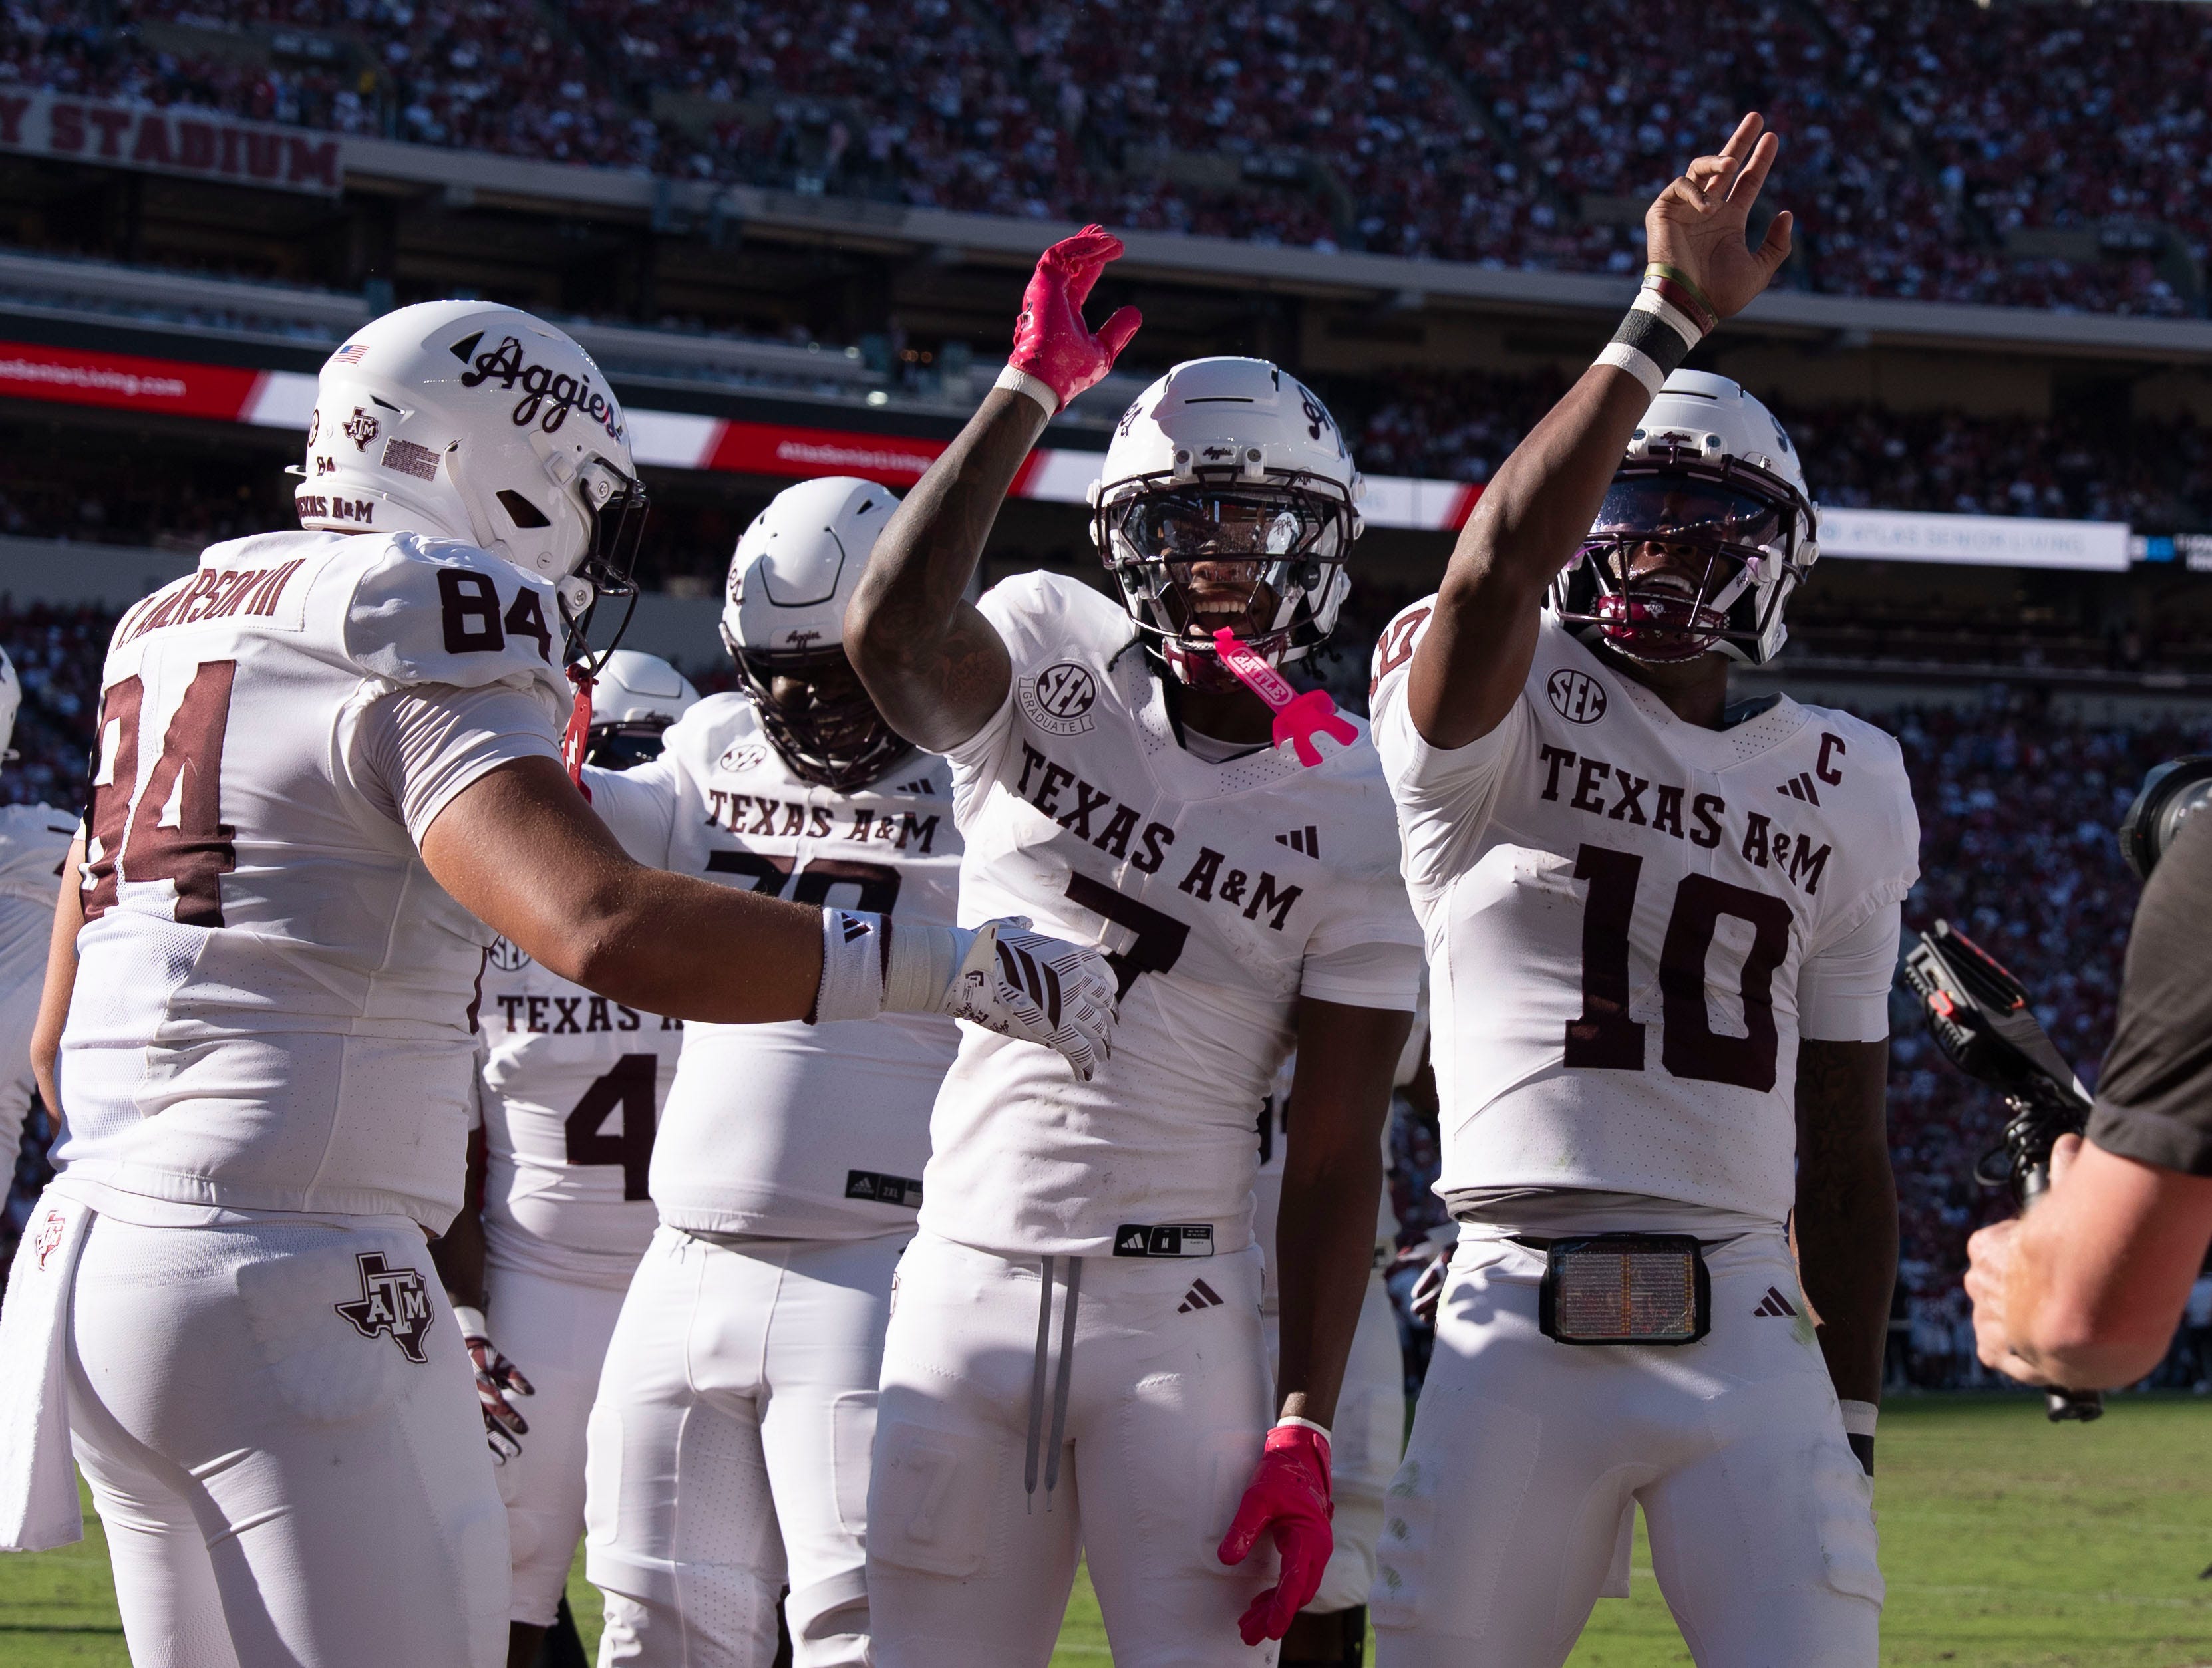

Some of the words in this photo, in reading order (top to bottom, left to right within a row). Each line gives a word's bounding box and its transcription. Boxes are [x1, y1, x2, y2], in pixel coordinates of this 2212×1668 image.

[51, 104, 341, 189] STADIUM
[461, 336, 621, 442] Aggies
[316, 456, 336, 477] 84
[332, 497, 374, 524] A&M
[436, 568, 552, 666] 84
[786, 630, 822, 649] Aggies
[1038, 665, 1094, 716] SEC
[1232, 651, 1287, 701] BATTLE
[1549, 670, 1605, 722] SEC
[1023, 691, 1076, 732] GRADUATE
[722, 745, 766, 772] SEC
[1816, 732, 1846, 787] C
[80, 659, 236, 929] 84
[704, 789, 835, 839] TEXAS
[844, 808, 941, 854] A&M
[1539, 743, 1726, 849] TEXAS
[1741, 811, 1833, 896] A&M
[1017, 738, 1176, 875] TEXAS
[1178, 845, 1304, 932] A&M
[1064, 871, 1191, 1003] 7
[1563, 842, 1794, 1093] 10
[496, 995, 641, 1034] TEXAS
[564, 1053, 658, 1201] 4
